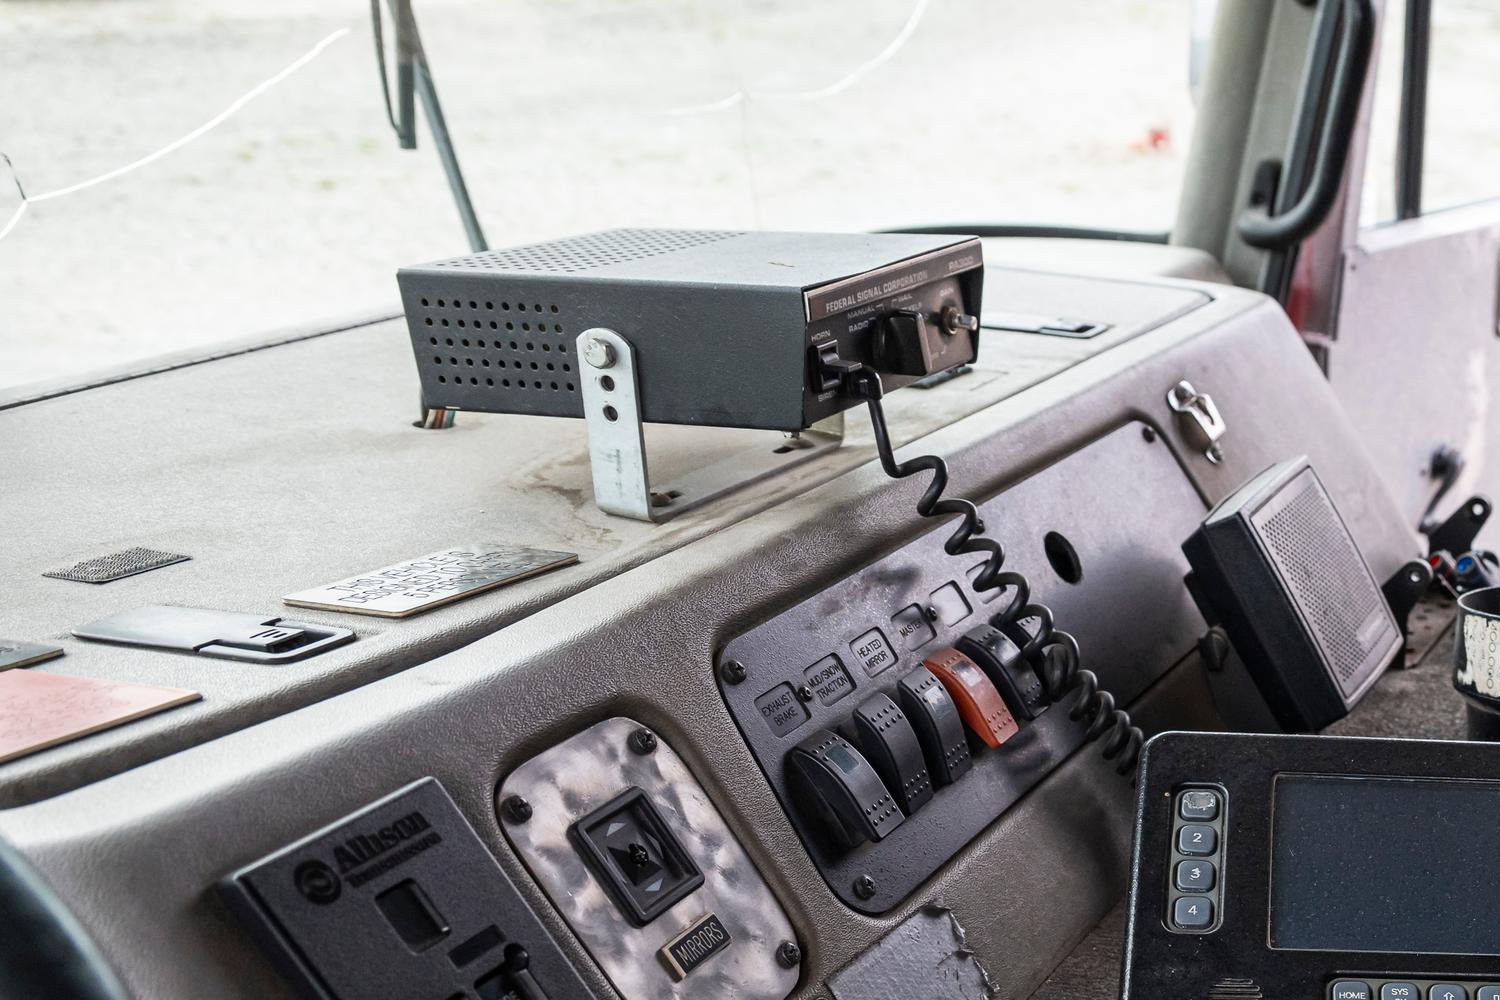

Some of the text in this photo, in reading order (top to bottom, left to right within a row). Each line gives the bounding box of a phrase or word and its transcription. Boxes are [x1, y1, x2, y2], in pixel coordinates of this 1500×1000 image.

[826, 270, 929, 313] FEDERAL SIGNAL CORPORATION
[848, 304, 875, 319] MANUAL
[848, 320, 870, 332] RADIO
[811, 329, 831, 342] HORN
[856, 638, 882, 658] HEATED
[865, 650, 889, 670] MIRROR
[808, 662, 842, 690] MUD/SNOW
[815, 675, 849, 700] TRACTION
[761, 691, 794, 718] EXHAUST
[774, 706, 799, 727] BRAKE
[1192, 832, 1202, 843] 2
[1190, 867, 1201, 880] 3
[1188, 904, 1198, 915] 4
[676, 922, 724, 966] MIRRORS
[1338, 991, 1366, 1000] HOME
[1391, 988, 1409, 996] SYS
